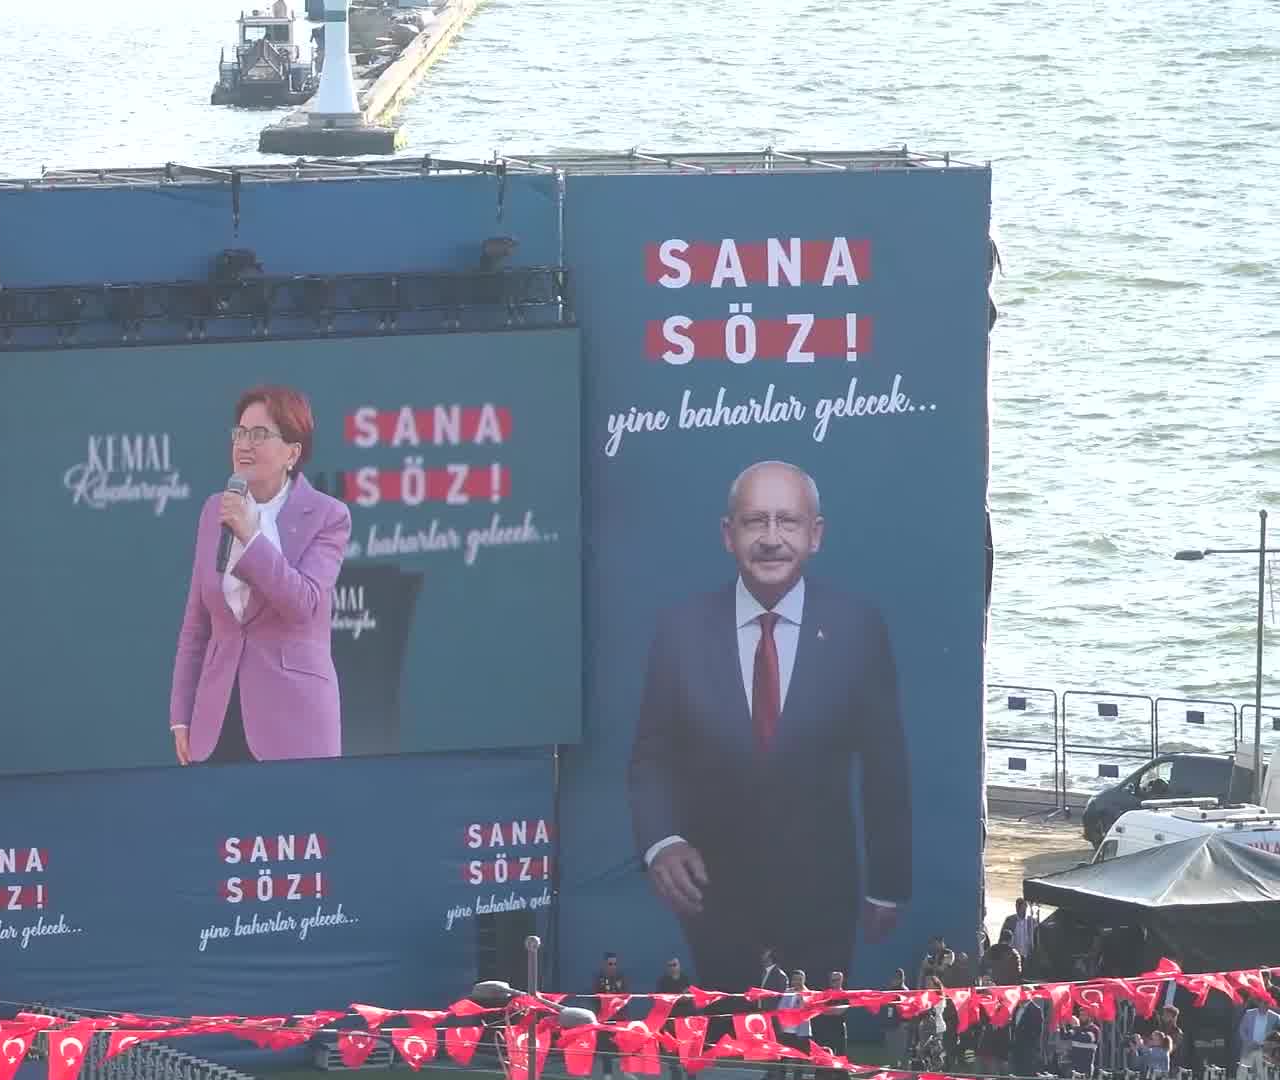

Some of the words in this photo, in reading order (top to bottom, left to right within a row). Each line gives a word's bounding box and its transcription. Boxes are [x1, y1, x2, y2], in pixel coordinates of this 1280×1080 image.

[658, 237, 860, 288] SANA
[662, 302, 858, 365] SÖZ!
[353, 404, 502, 448] SANA
[605, 403, 669, 457] yine
[679, 383, 806, 430] baharlar
[814, 373, 937, 443] gelecek...
[356, 460, 502, 507] SÖZ!
[367, 520, 461, 557] baharlar
[225, 833, 322, 864] SANA
[468, 820, 549, 849] SANA
[226, 869, 322, 903] SÖZ!
[469, 854, 549, 885] SÖZ!
[199, 926, 231, 951] yine
[234, 912, 297, 937] baharlar
[300, 904, 360, 940] gelecek...
[445, 905, 472, 930] yine
[476, 892, 527, 915] baharlar
[21, 914, 83, 949] gelecek...
